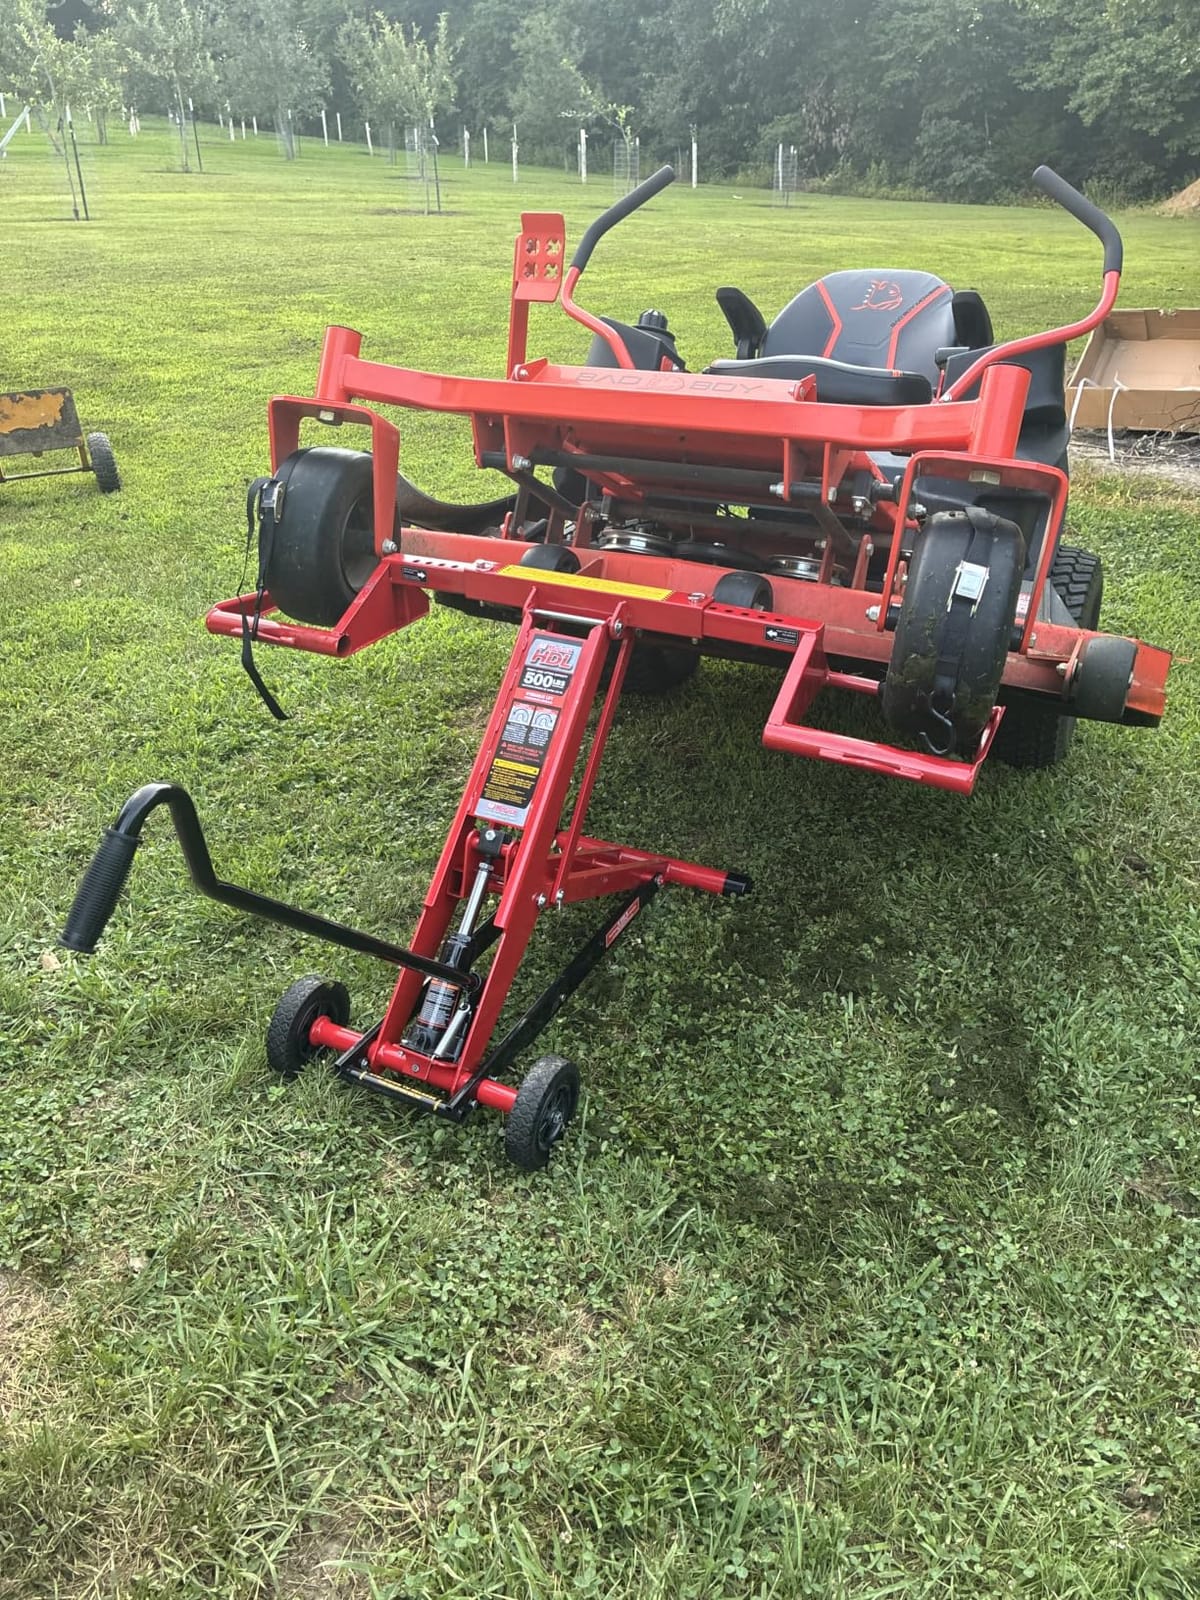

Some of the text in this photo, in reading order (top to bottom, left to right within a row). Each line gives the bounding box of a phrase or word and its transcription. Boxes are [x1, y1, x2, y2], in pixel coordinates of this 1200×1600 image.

[576, 372, 763, 393] BAD BOY
[531, 647, 572, 669] HDL
[523, 671, 554, 688] 500
